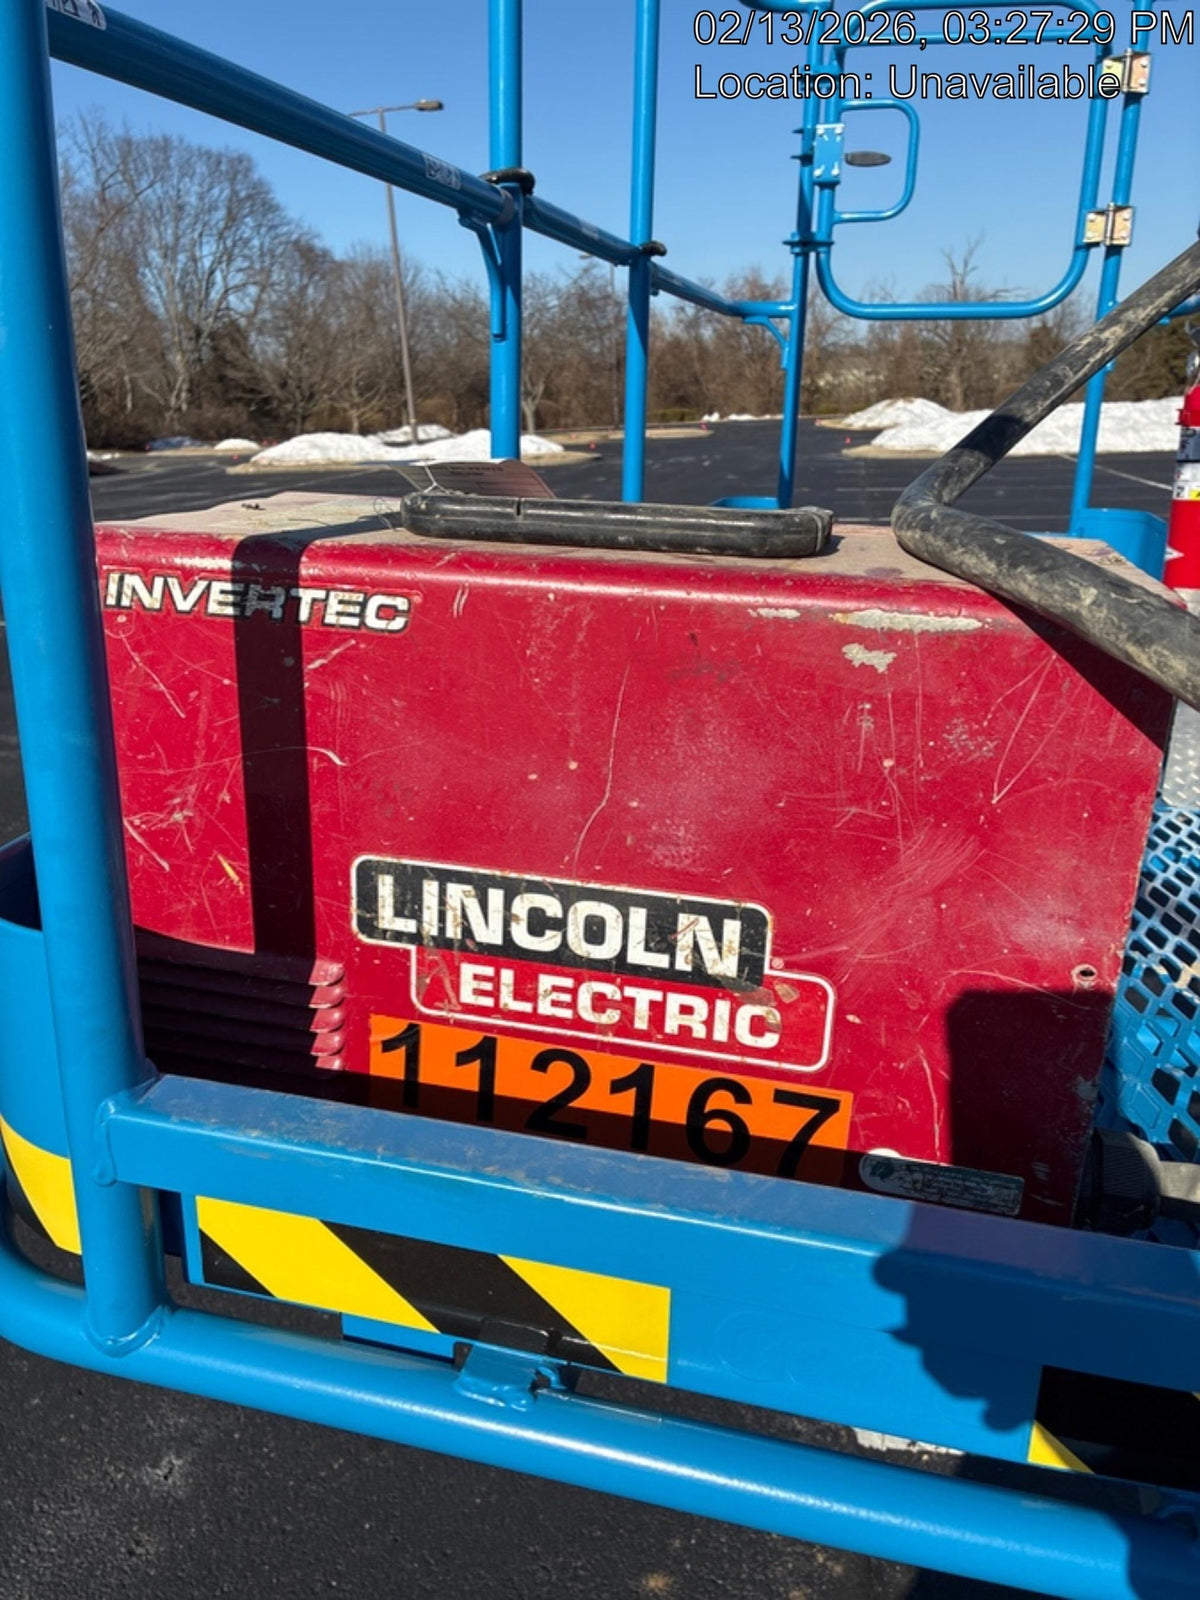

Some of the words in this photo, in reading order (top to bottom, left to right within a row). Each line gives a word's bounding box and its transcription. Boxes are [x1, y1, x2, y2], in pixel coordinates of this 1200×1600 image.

[104, 571, 410, 632] INVERTEC
[376, 873, 742, 978] LINCOLN
[459, 962, 782, 1050] ELECTRIC
[380, 1022, 841, 1179] 112167
